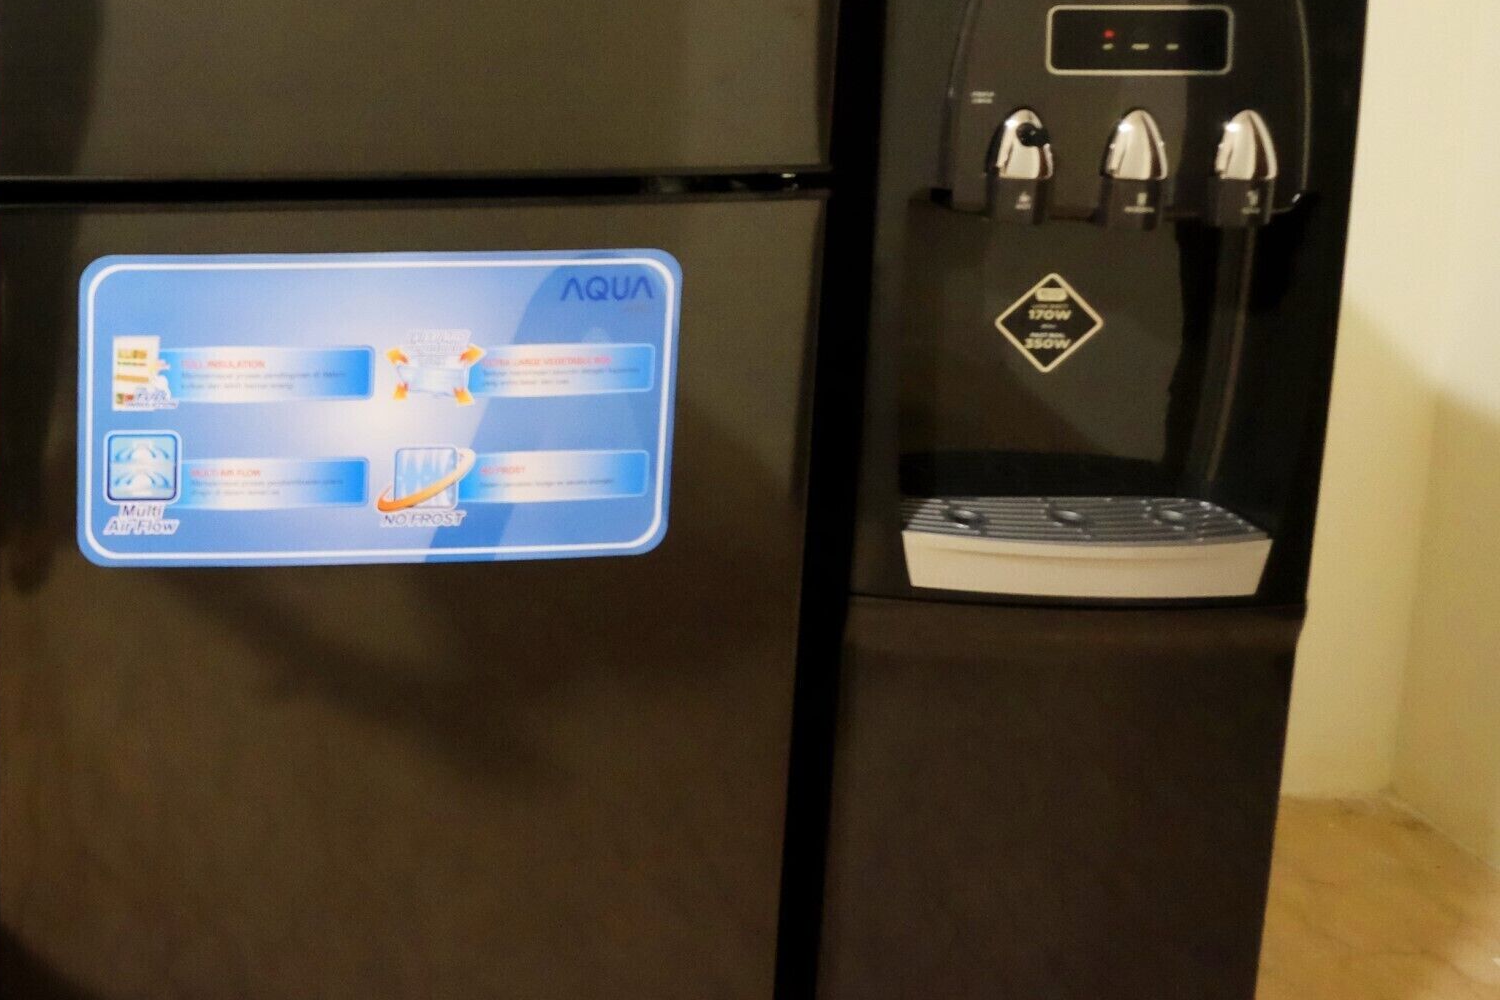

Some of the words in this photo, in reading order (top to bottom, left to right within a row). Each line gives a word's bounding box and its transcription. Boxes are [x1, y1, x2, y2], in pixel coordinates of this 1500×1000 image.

[560, 275, 655, 301] AQUA
[1028, 309, 1072, 320] 170W
[122, 504, 162, 517] Multi
[383, 513, 408, 525] NO
[411, 512, 464, 525] FROST
